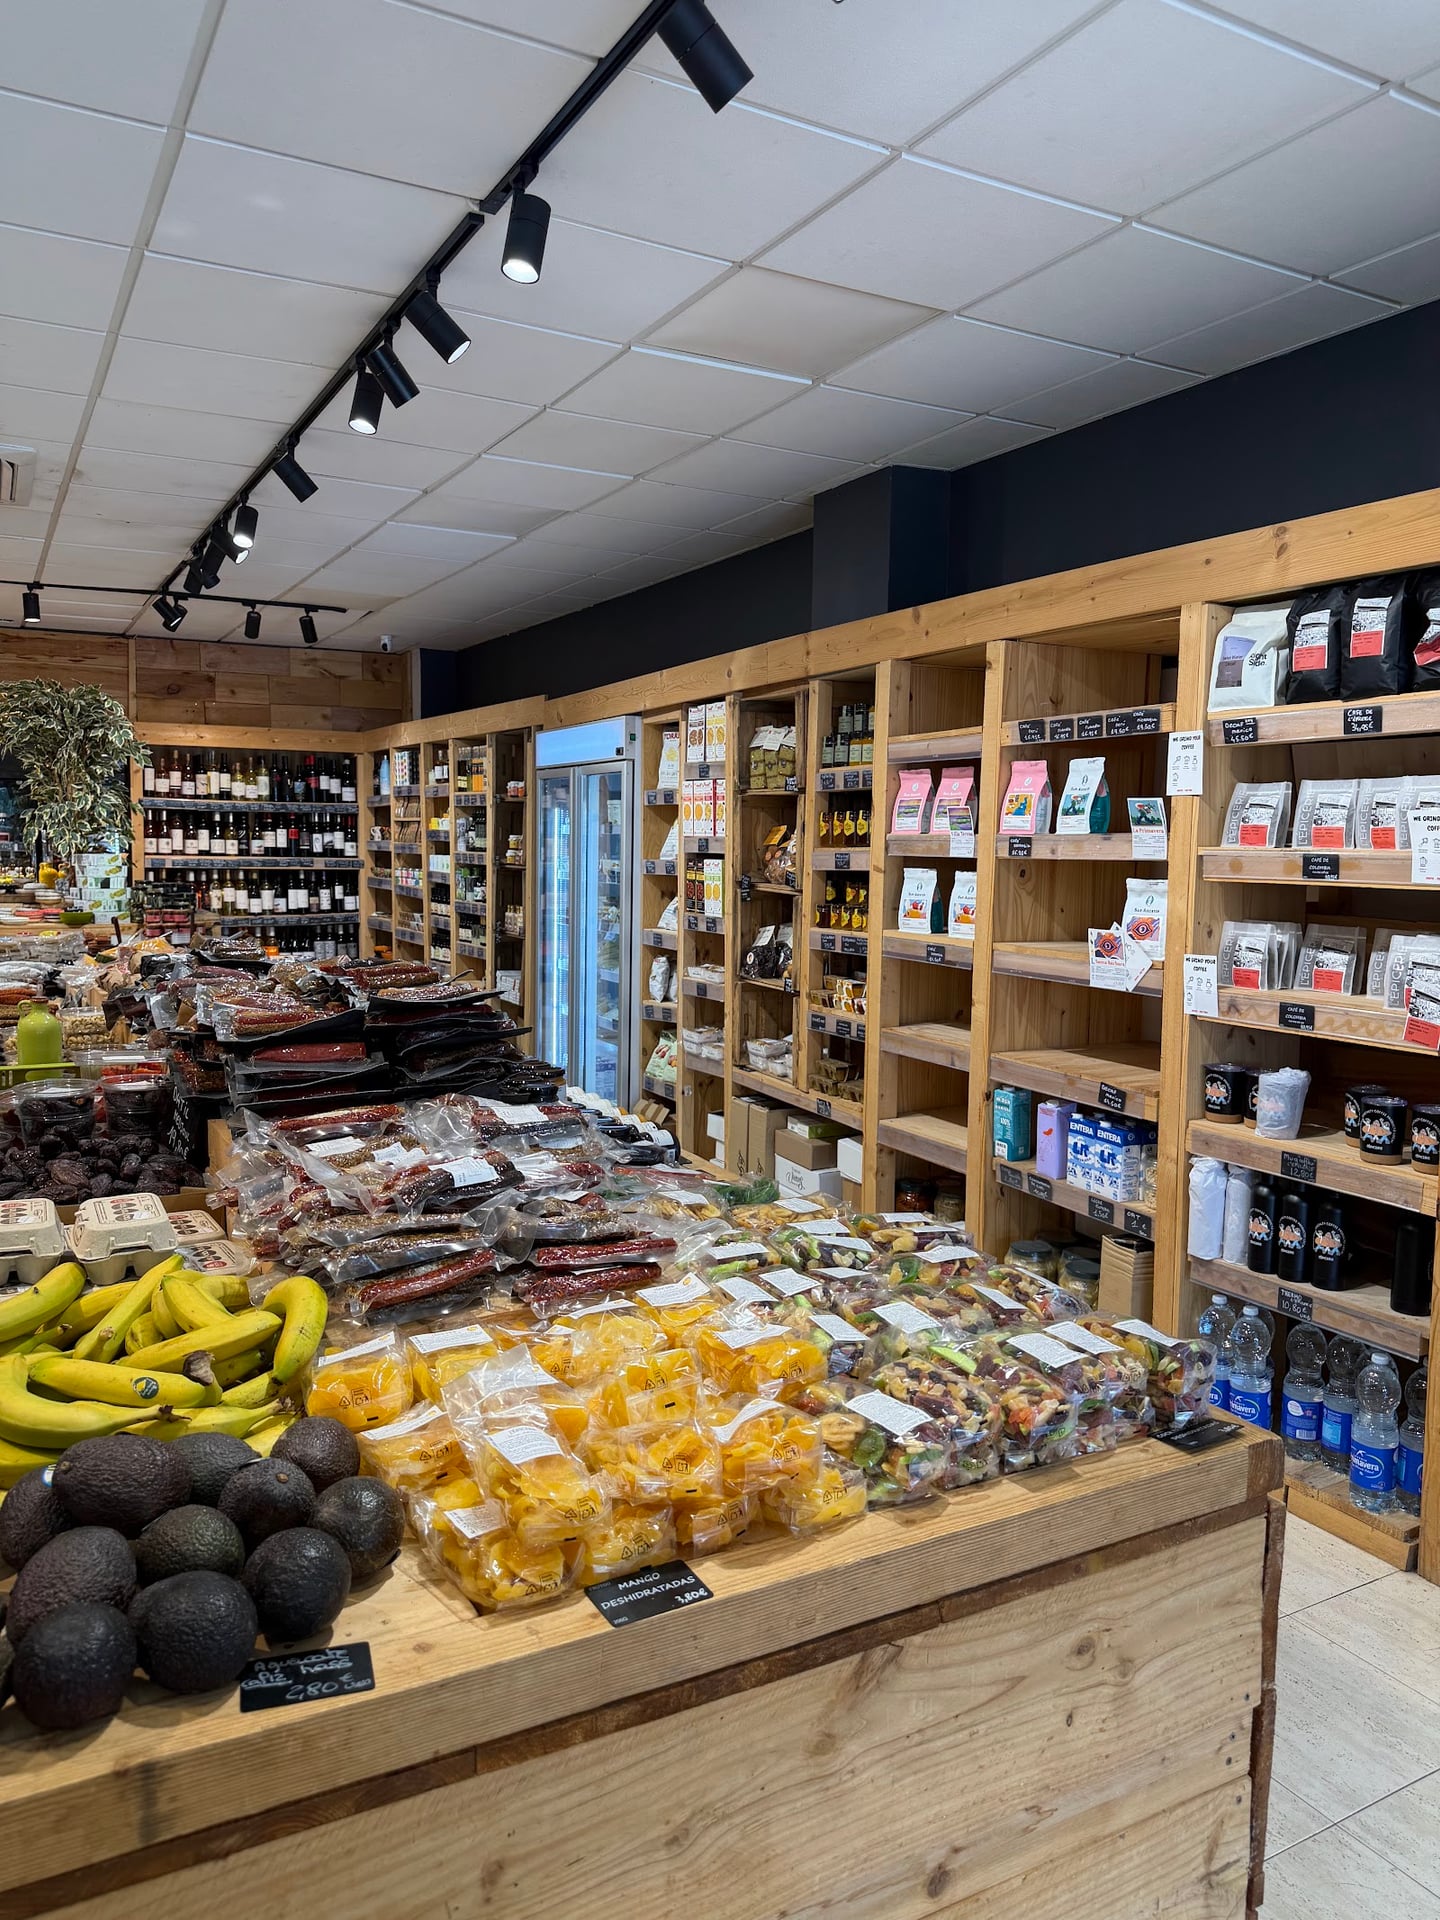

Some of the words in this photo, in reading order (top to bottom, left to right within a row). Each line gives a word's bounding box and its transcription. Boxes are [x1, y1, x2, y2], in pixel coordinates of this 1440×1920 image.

[1069, 1122, 1094, 1135] ENTERA
[1097, 1129, 1122, 1144] ENTERA
[617, 1571, 661, 1591] MANGO
[600, 1574, 696, 1611] DESHIDRATADAS
[674, 1586, 709, 1604] 3,80€
